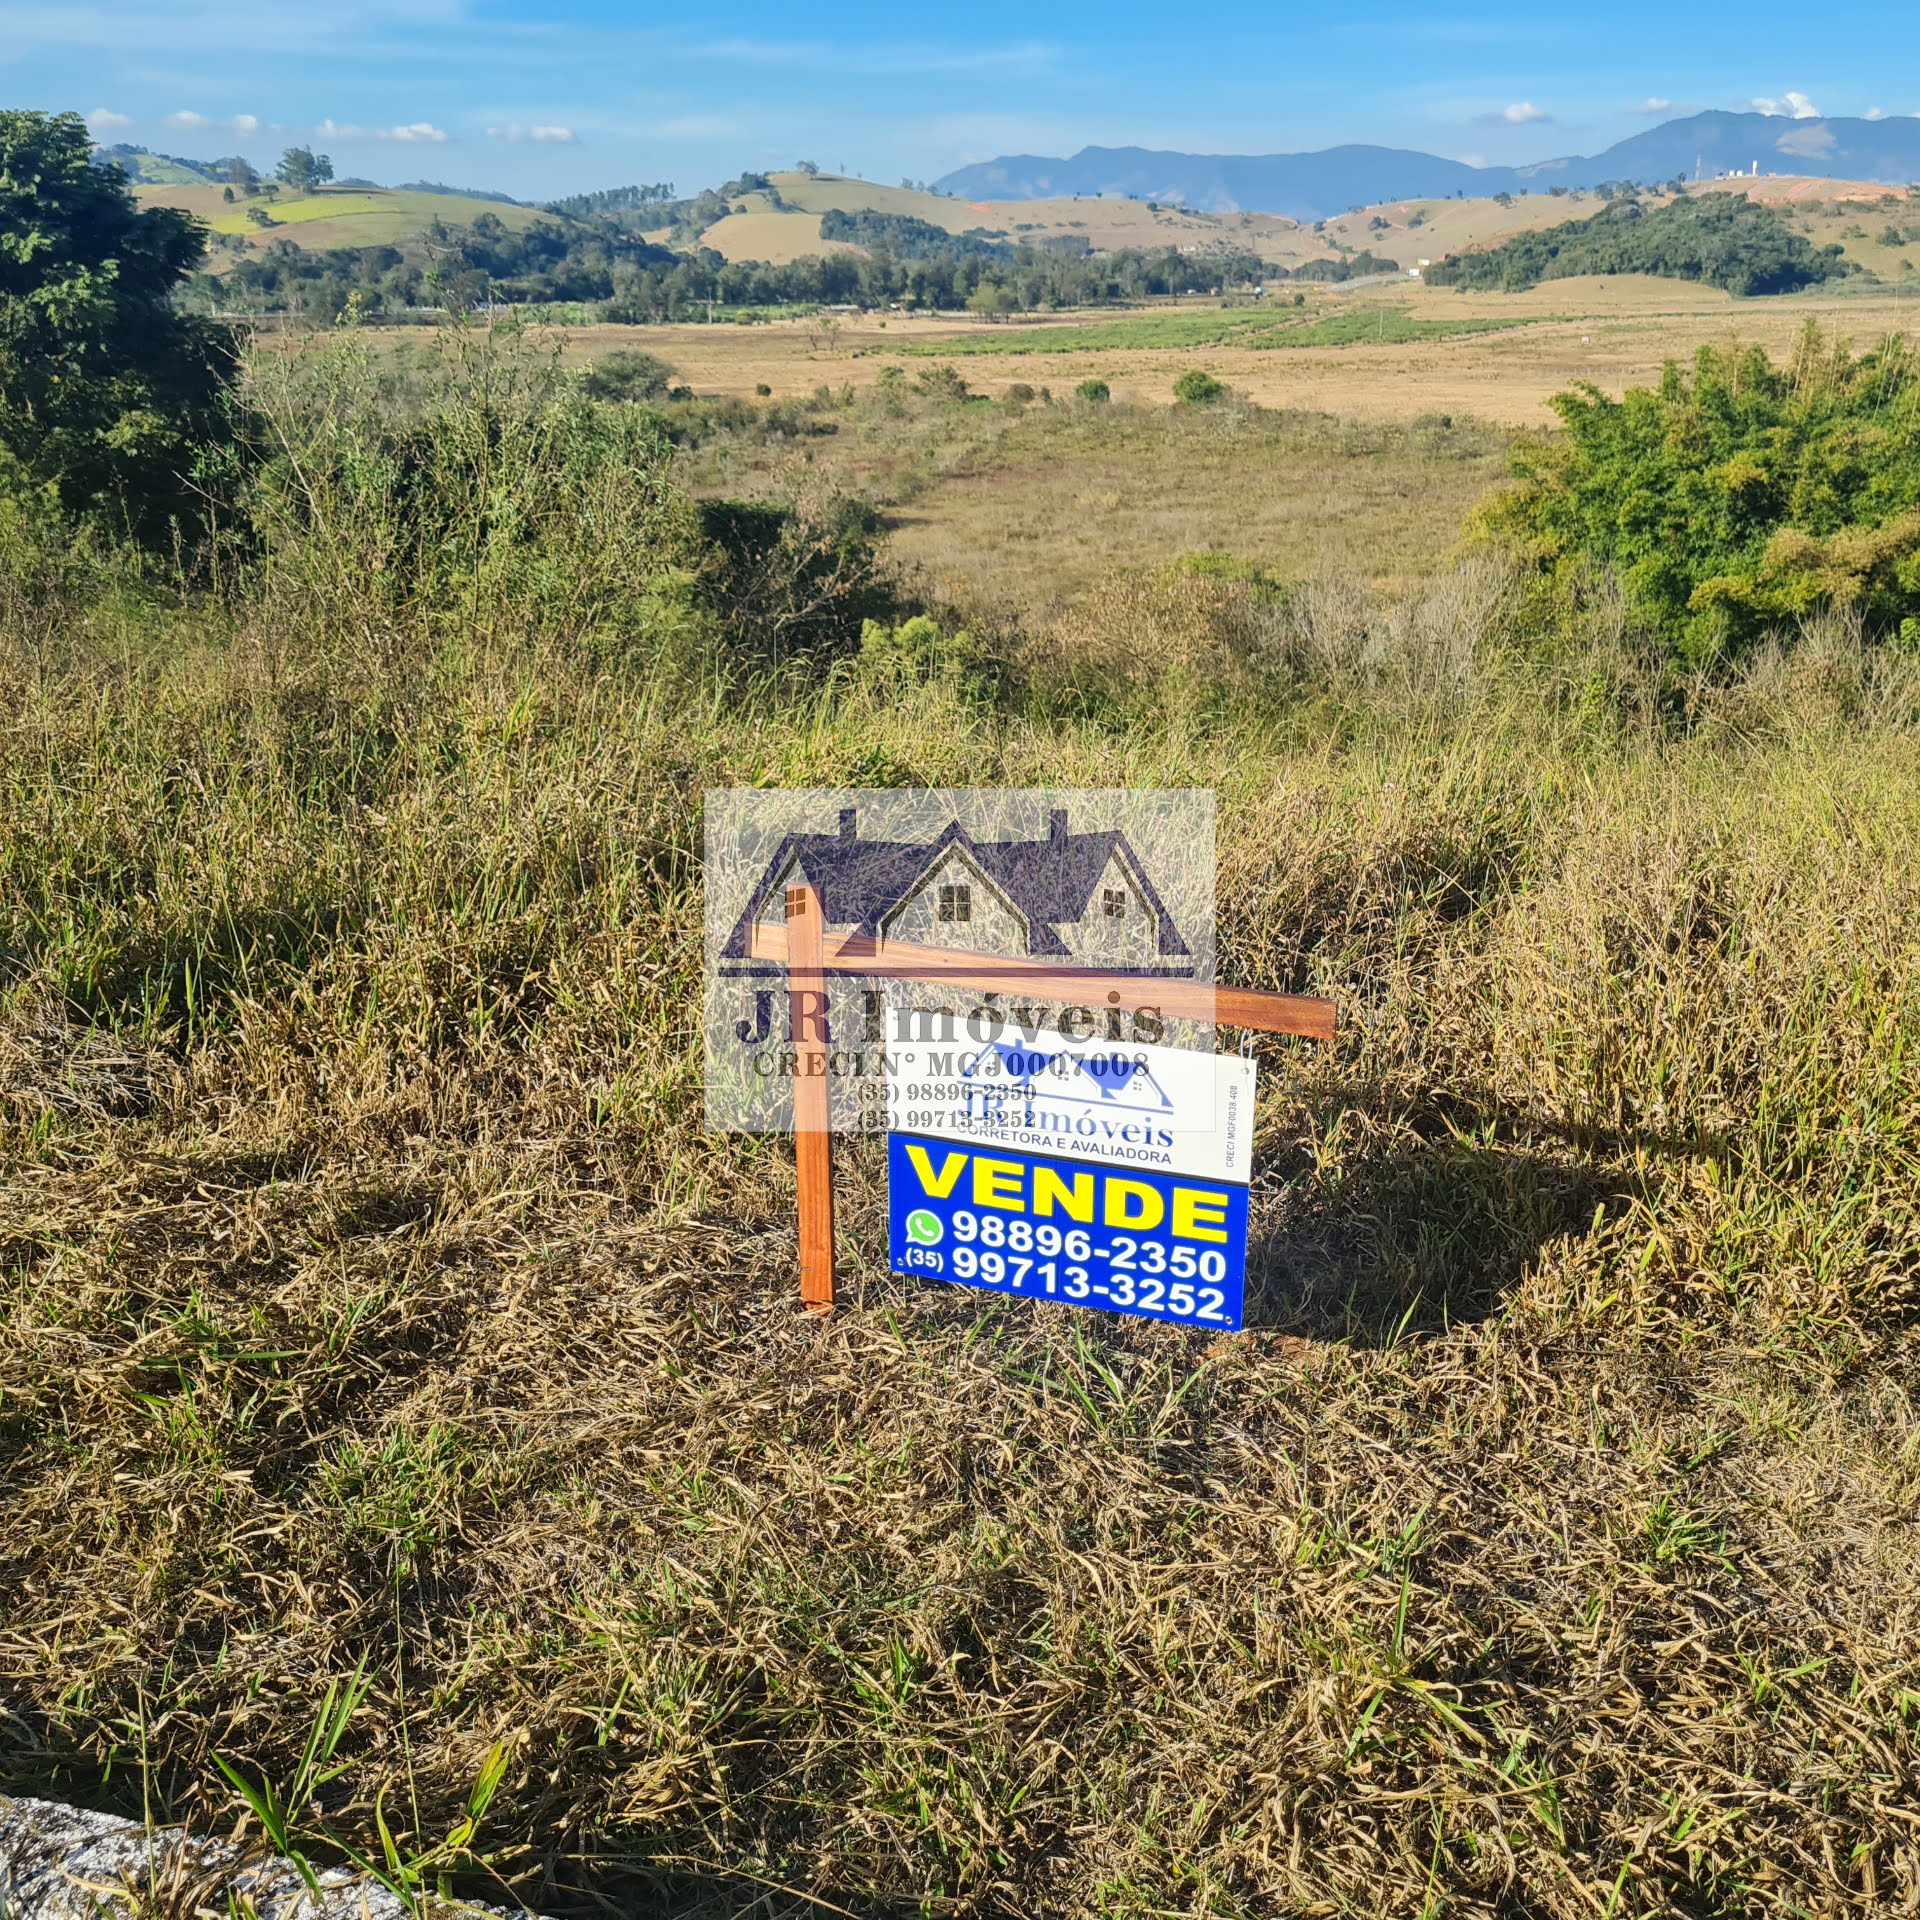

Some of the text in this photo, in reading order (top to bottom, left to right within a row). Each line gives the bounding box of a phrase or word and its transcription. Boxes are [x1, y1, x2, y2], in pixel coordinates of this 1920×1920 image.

[957, 1089, 1174, 1148] JR Imóveis
[957, 1122, 1172, 1165] CORRETORA E AVALIADORA
[1226, 1141, 1236, 1168] CRECI
[904, 1143, 1229, 1244] VENDE
[951, 1210, 1227, 1283] 98896-2350
[905, 1246, 1225, 1321] (35) 99713-3252
